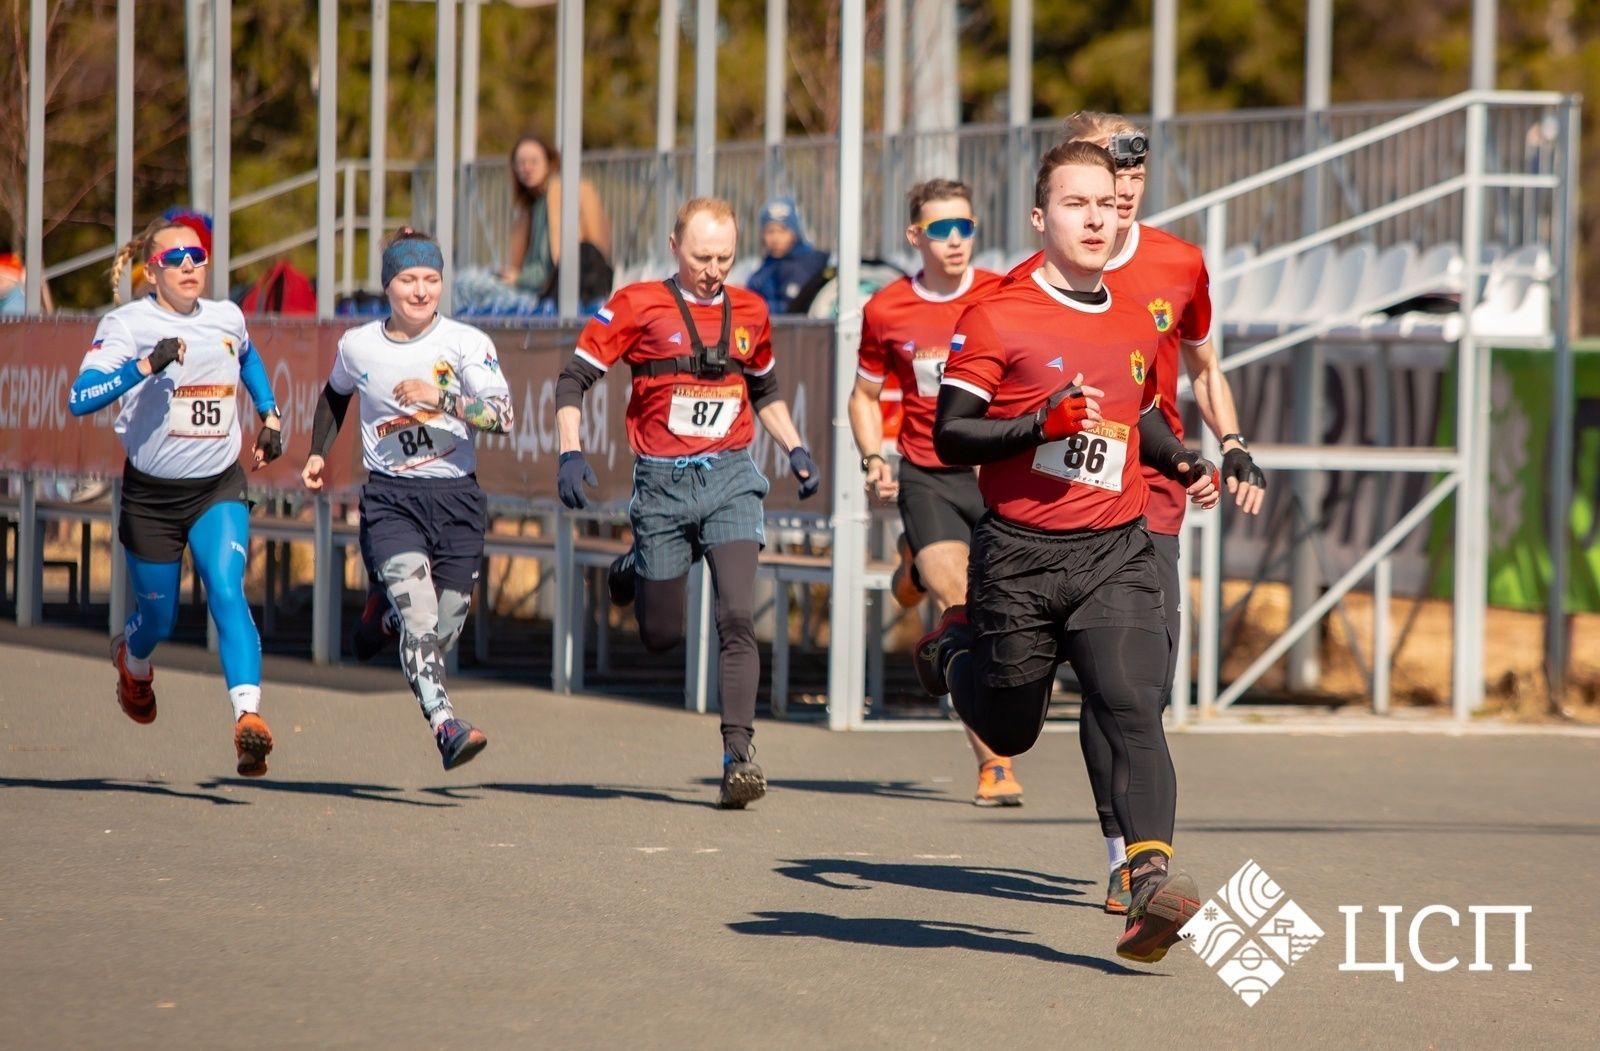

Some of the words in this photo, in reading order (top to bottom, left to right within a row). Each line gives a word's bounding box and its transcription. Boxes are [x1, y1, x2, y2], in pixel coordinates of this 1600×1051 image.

[0, 363, 68, 432] СЕРВИС
[80, 375, 122, 402] FIGHTS
[191, 400, 221, 426] 85
[692, 401, 724, 427] 87
[398, 425, 434, 457] 84
[1063, 434, 1108, 474] 86
